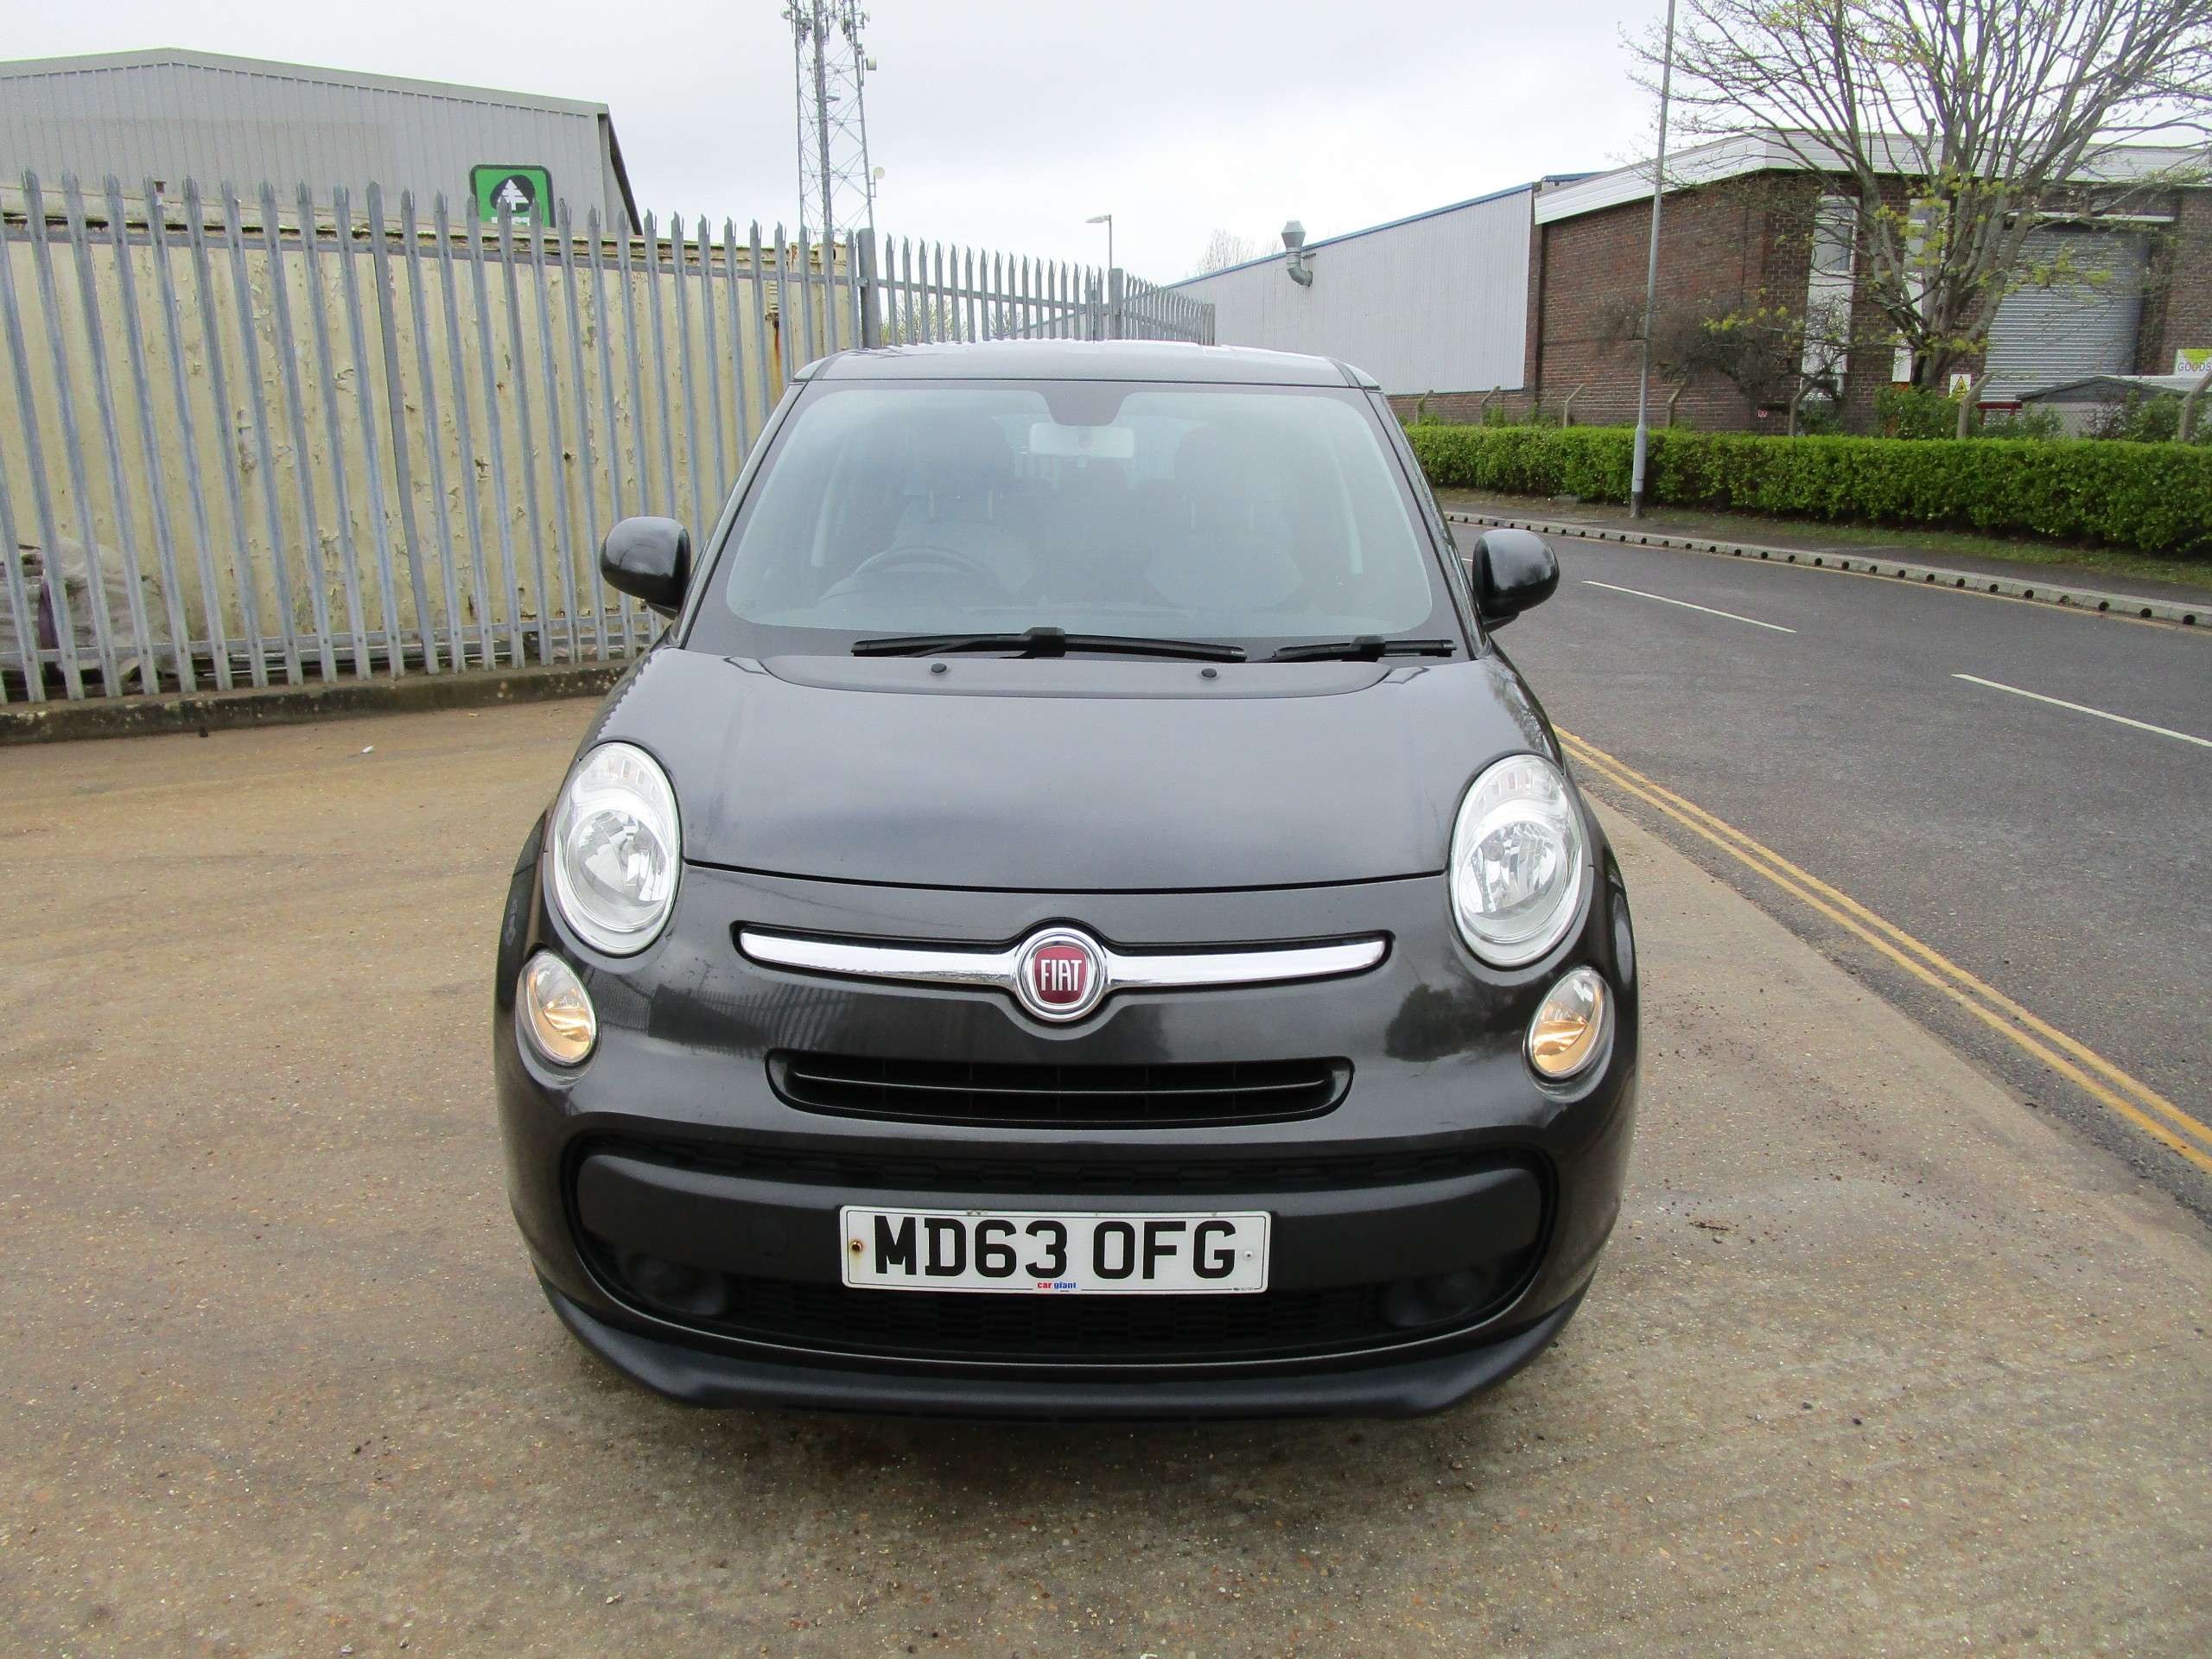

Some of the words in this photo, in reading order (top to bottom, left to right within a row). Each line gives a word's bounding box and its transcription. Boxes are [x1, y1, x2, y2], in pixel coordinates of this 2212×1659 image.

[1040, 959, 1082, 991] FIAT
[874, 1215, 1068, 1279] MD63
[1092, 1220, 1236, 1280] OFG
[1053, 1281, 1077, 1289] giant
